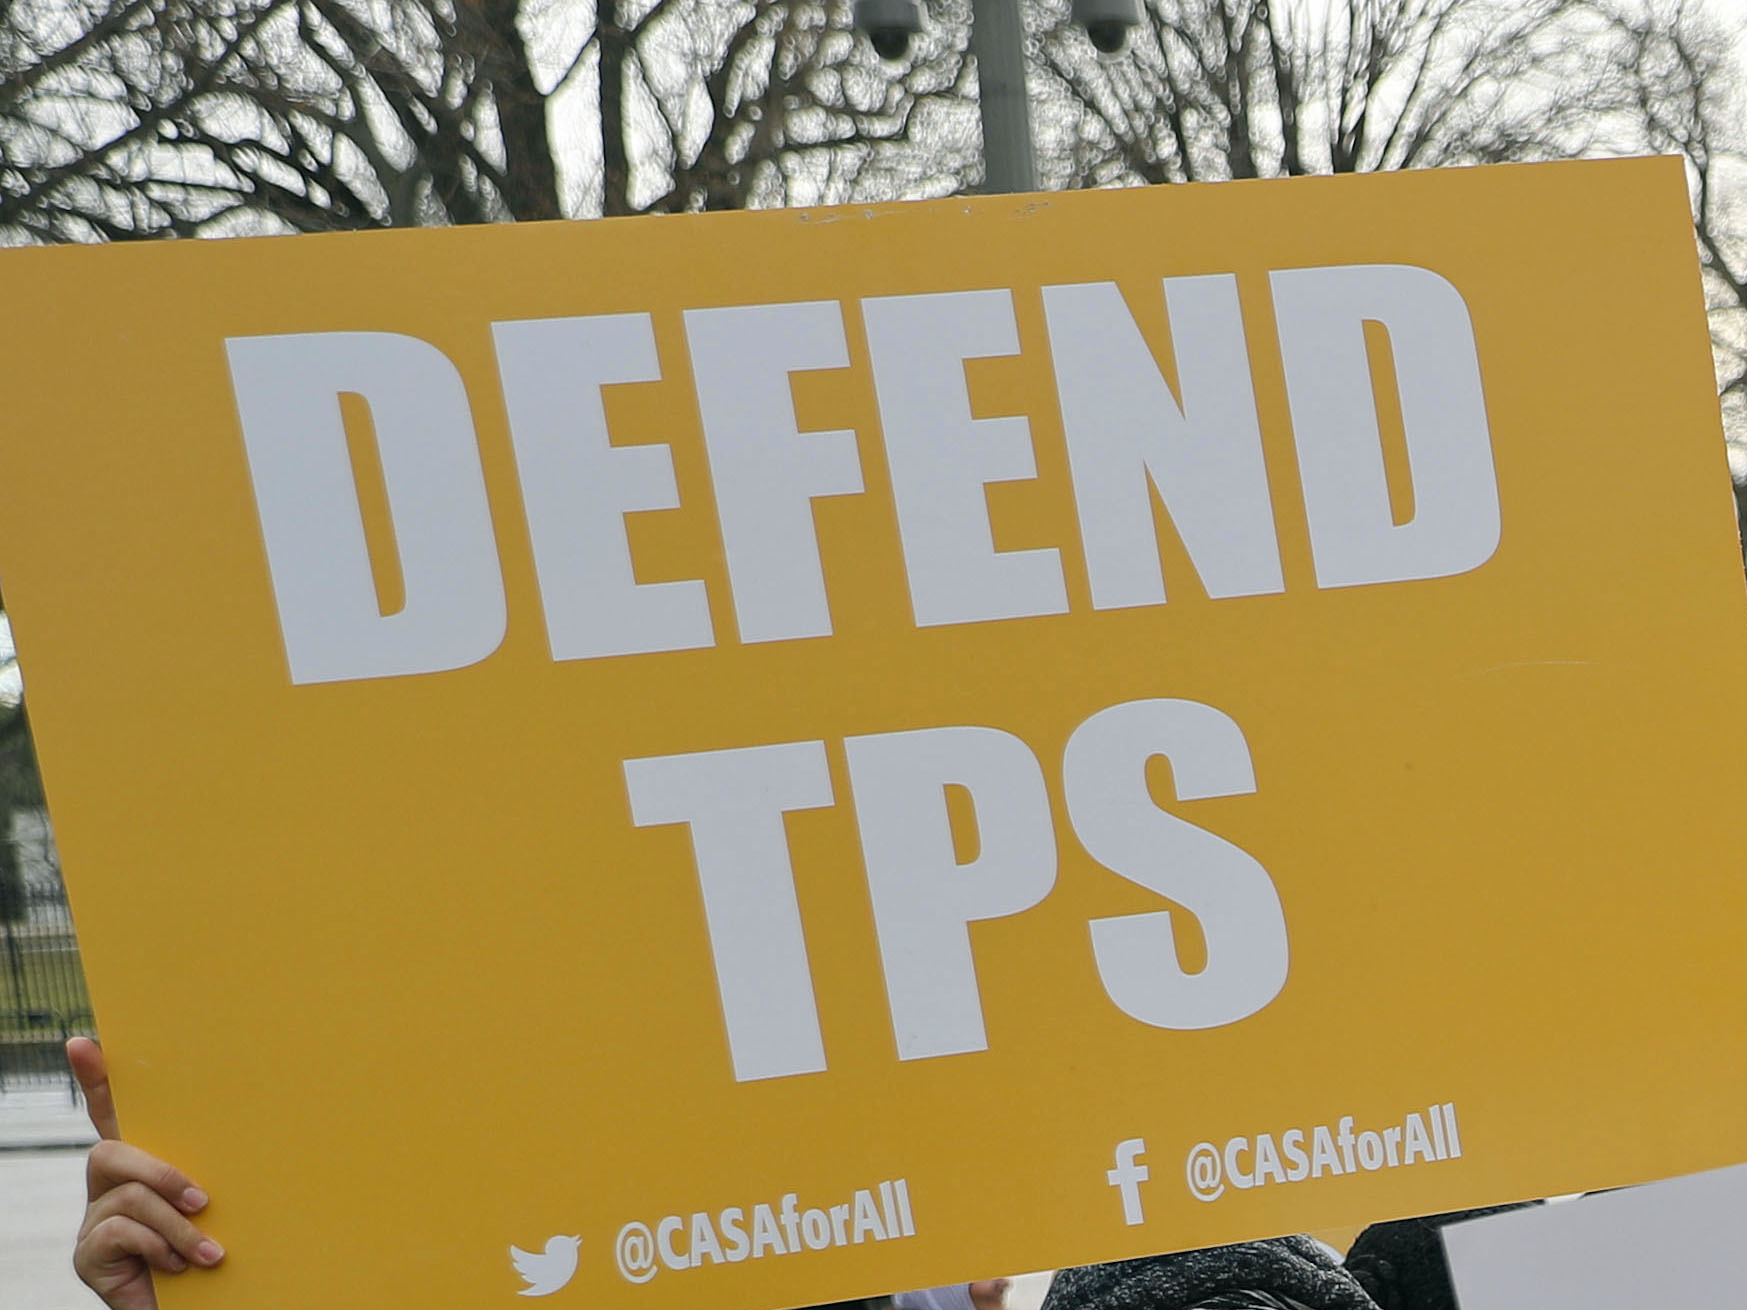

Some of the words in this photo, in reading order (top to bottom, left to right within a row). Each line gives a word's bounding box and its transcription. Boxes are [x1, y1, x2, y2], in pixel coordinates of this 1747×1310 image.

[224, 262, 1502, 686] DEFEND
[622, 698, 1290, 1083] TPS
[616, 1178, 915, 1284] @CASAforAll
[1186, 1102, 1462, 1202] @CASAforAll
